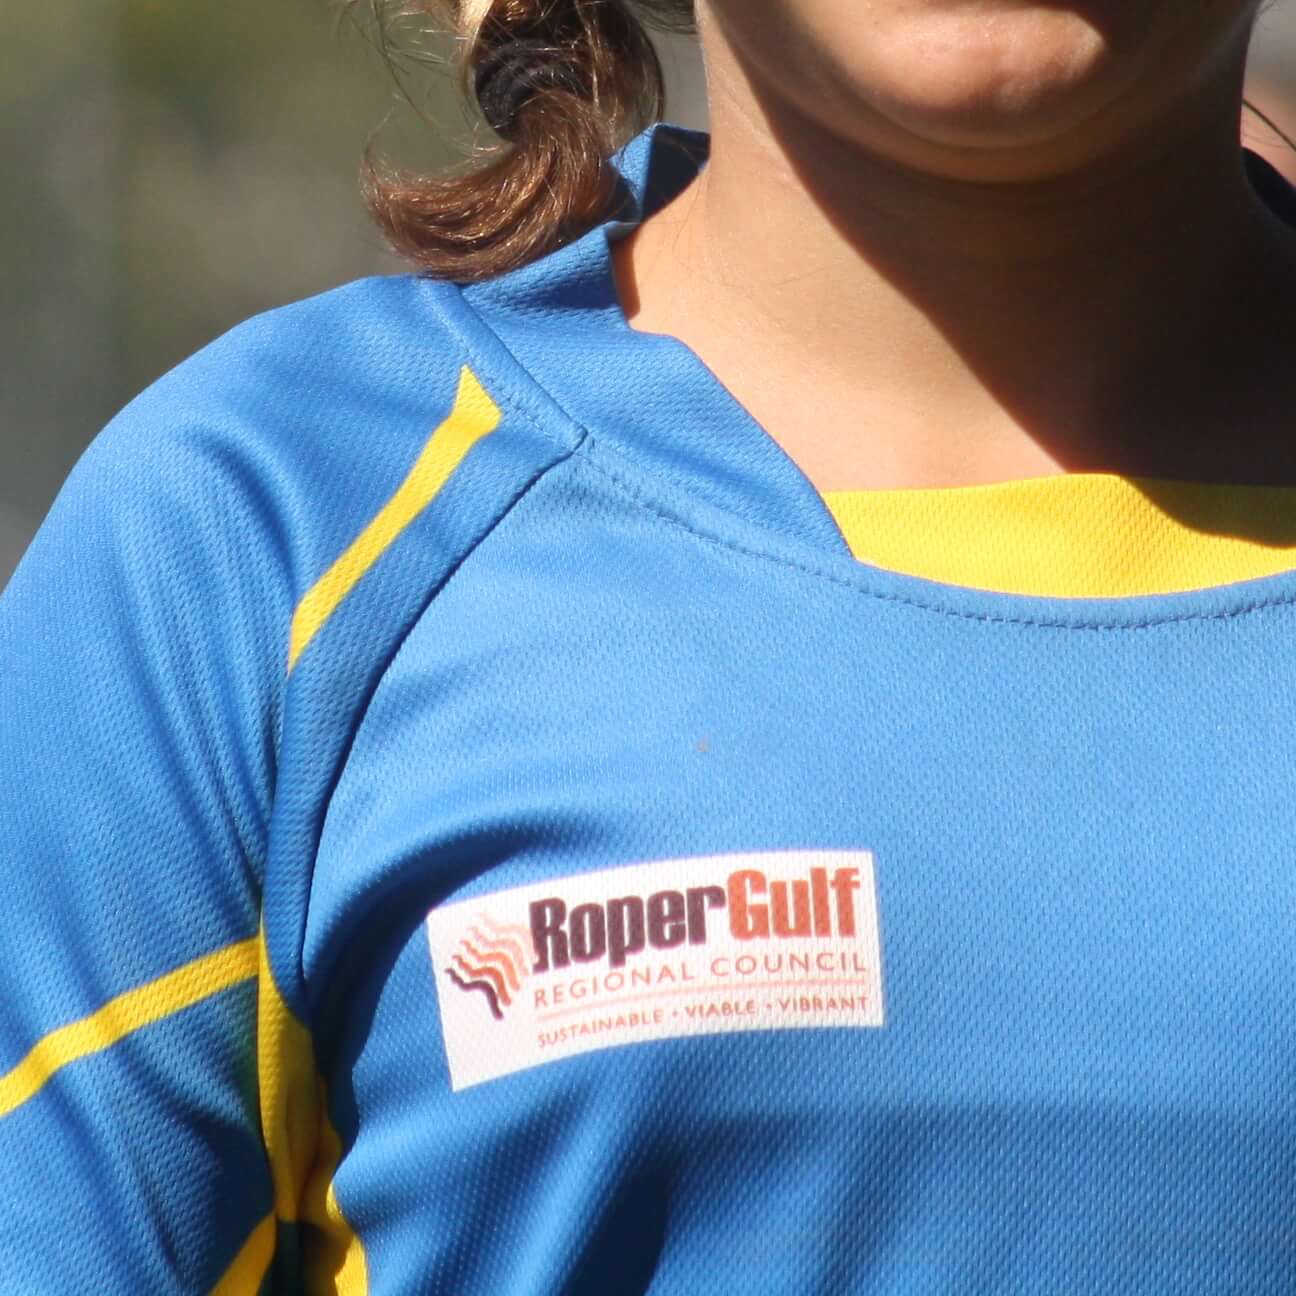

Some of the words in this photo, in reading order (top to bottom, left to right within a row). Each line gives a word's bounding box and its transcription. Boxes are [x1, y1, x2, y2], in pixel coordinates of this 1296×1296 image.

[534, 962, 695, 1007] REGIONAL
[710, 951, 867, 977] COUNCIL
[537, 1008, 664, 1049] SUSTAINABLE
[684, 999, 757, 1019] VIABLE
[778, 994, 870, 1015] VIBRANT
